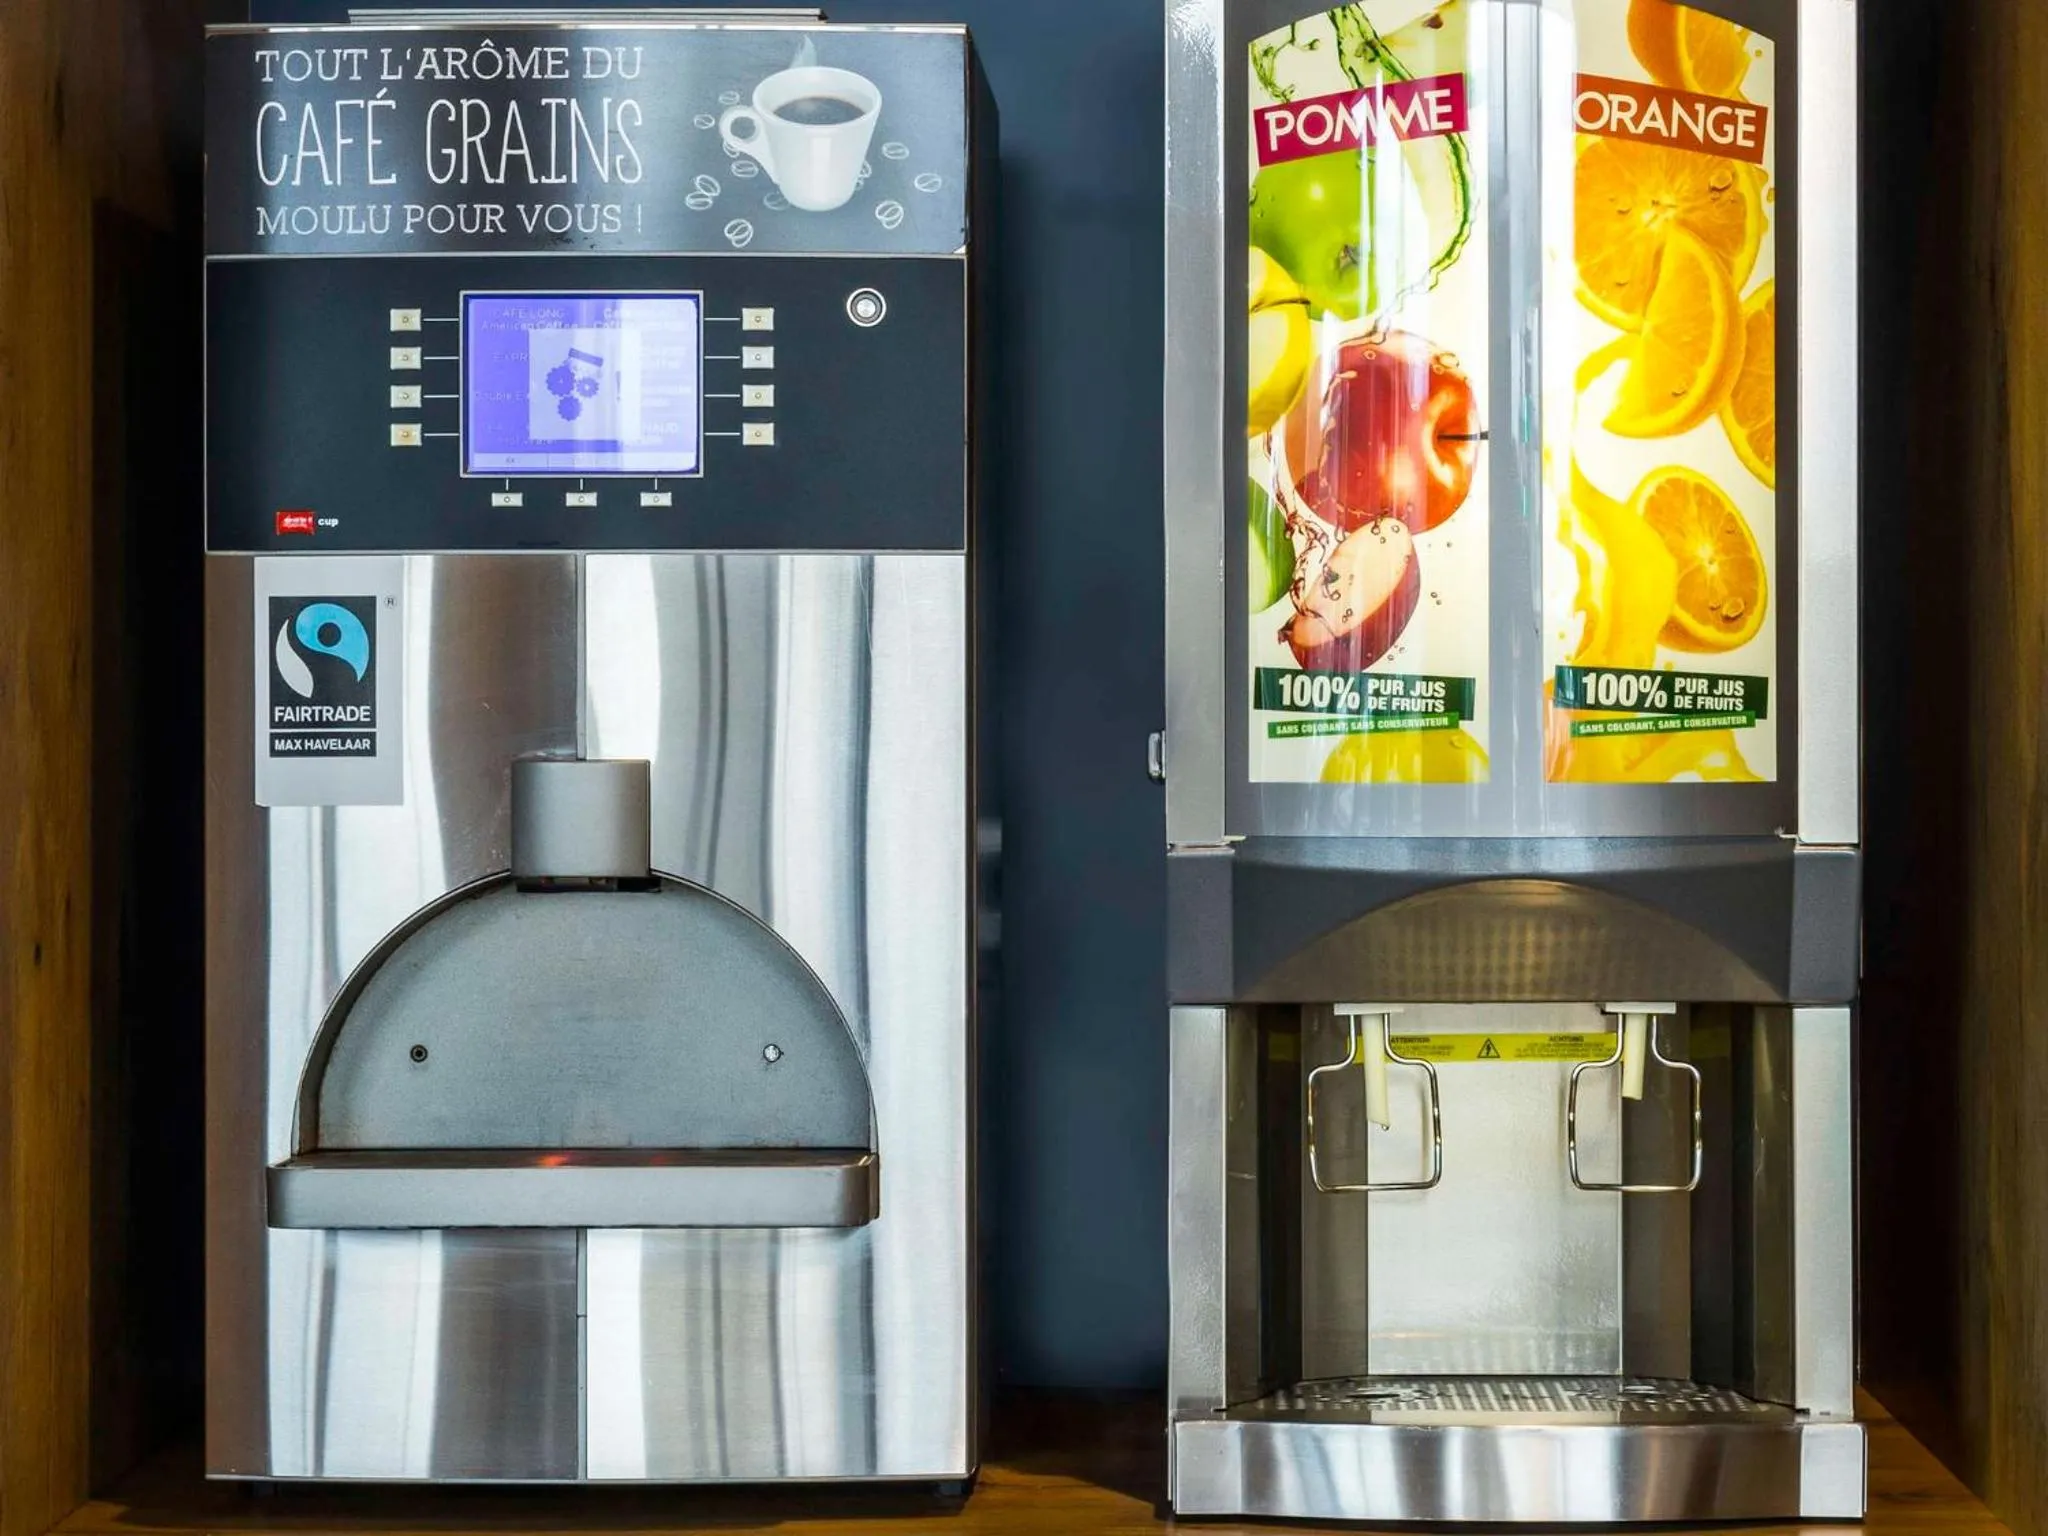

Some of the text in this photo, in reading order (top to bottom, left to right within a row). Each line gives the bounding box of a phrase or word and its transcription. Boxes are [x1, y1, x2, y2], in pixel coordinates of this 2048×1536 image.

[255, 39, 643, 82] TOUT L'ARÔME DU
[1264, 89, 1453, 151] POMME
[1574, 91, 1757, 149] ORANGE
[256, 87, 642, 186] CAFÉ GRAINS
[256, 206, 391, 235] MOULU
[403, 204, 506, 234] POUR
[518, 203, 621, 233] VOUS
[318, 518, 339, 528] cup
[1278, 673, 1446, 711] 100% PUR JUS
[1582, 671, 1745, 709] 100% PUR JUS
[274, 705, 372, 724] FAIRTRADE
[1368, 697, 1445, 713] DE FRUITS
[1674, 695, 1744, 712] DE FRUITS
[1276, 724, 1299, 735] SANS
[1352, 720, 1375, 731] SANS
[1378, 717, 1449, 730] CONSERVATEUR
[1579, 715, 1747, 734] SANS COLORANT, SANS CONSERVATEUR
[274, 738, 371, 751] MAX HAVELAAR
